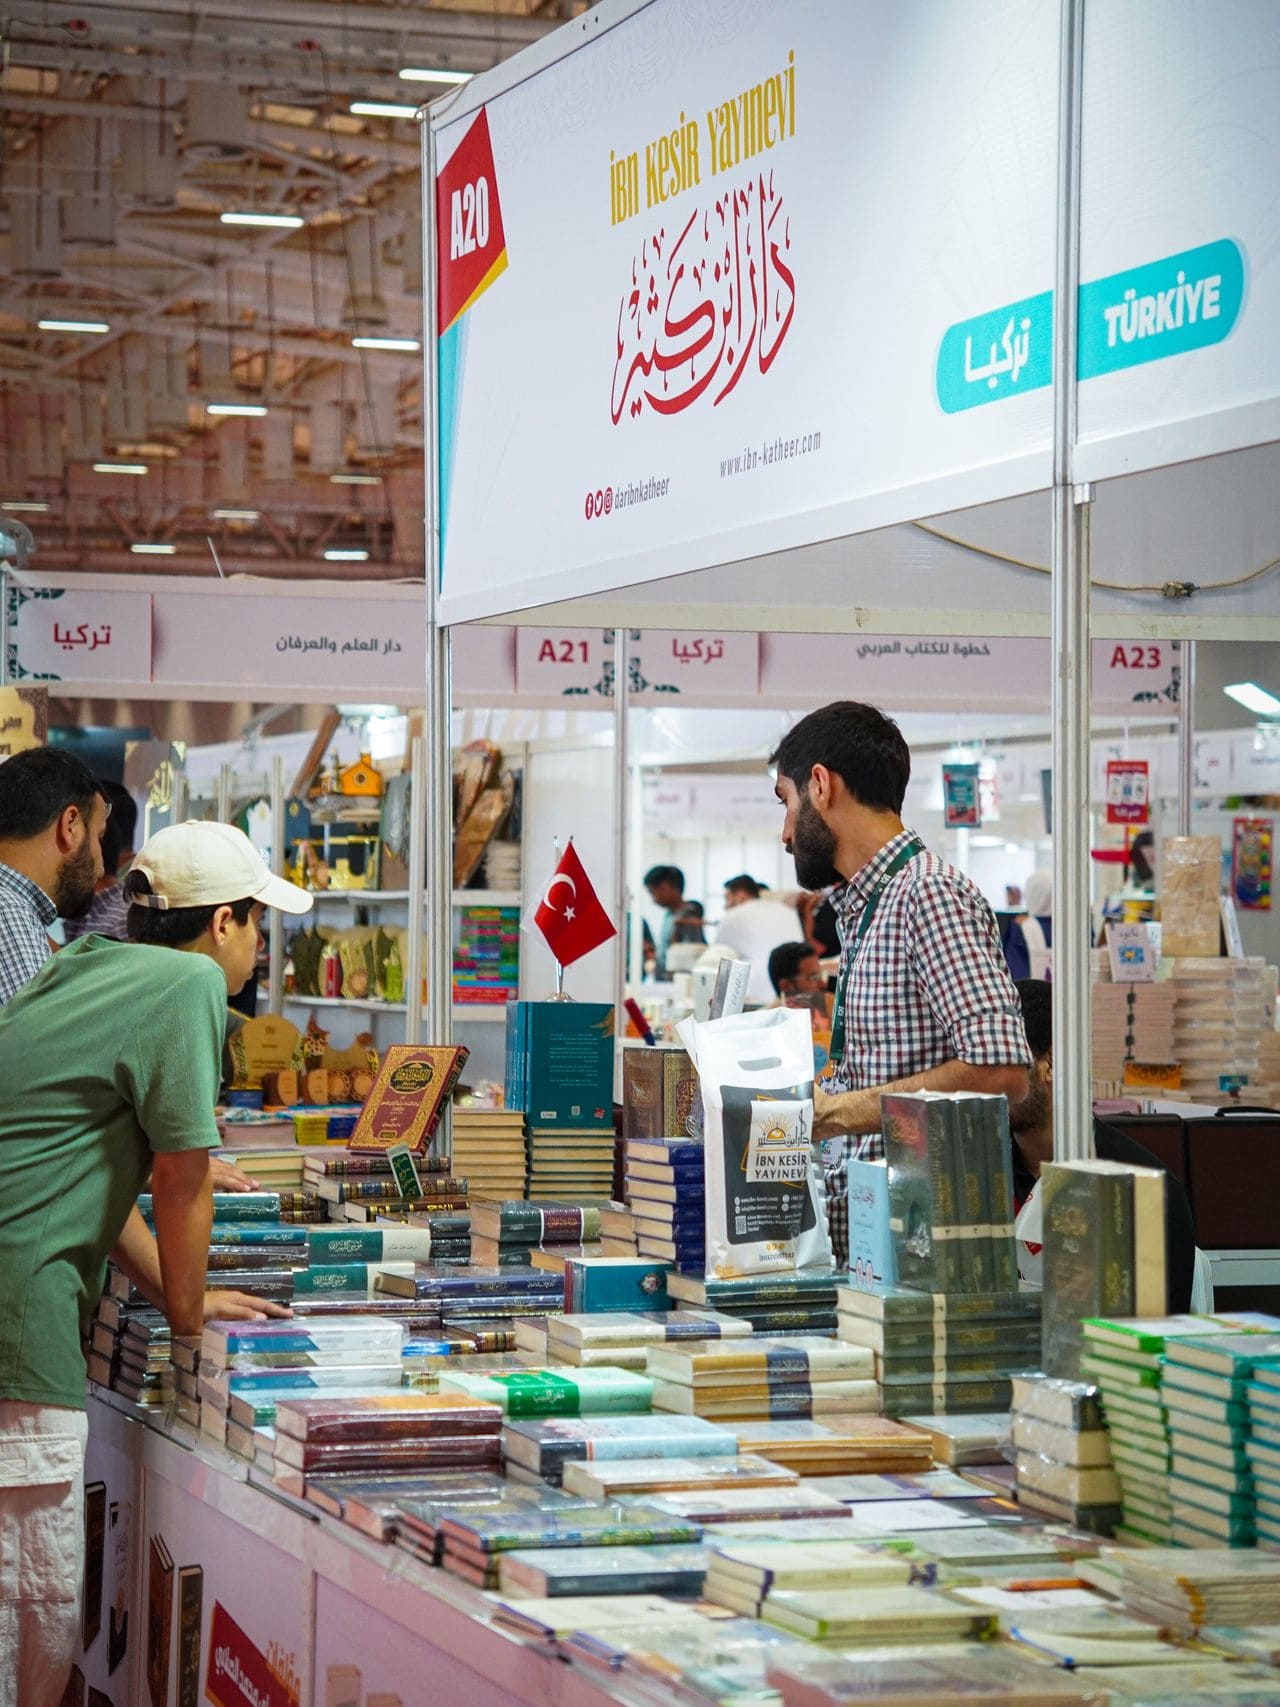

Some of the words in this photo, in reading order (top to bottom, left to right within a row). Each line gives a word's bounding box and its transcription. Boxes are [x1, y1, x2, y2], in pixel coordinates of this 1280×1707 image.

[450, 176, 490, 262] A20
[1104, 270, 1222, 348] TÜRKİYE
[964, 316, 1032, 390] تركيا
[719, 431, 821, 479] www.ibn-katheer.com
[614, 476, 671, 510] daribnkatheer
[53, 623, 111, 650] تركيا
[276, 635, 337, 653] والعرفان
[341, 637, 379, 654] العلم
[383, 637, 402, 655] دار
[904, 640, 950, 657] للكتاب
[538, 639, 589, 663] A21
[672, 638, 724, 663] تركيا
[856, 640, 902, 660] العربي
[952, 641, 991, 660] خطوة
[1110, 645, 1161, 669] A23
[755, 1153, 776, 1167] İBN
[778, 1152, 808, 1166] KESİR
[755, 1167, 808, 1180] YAYINEVİ
